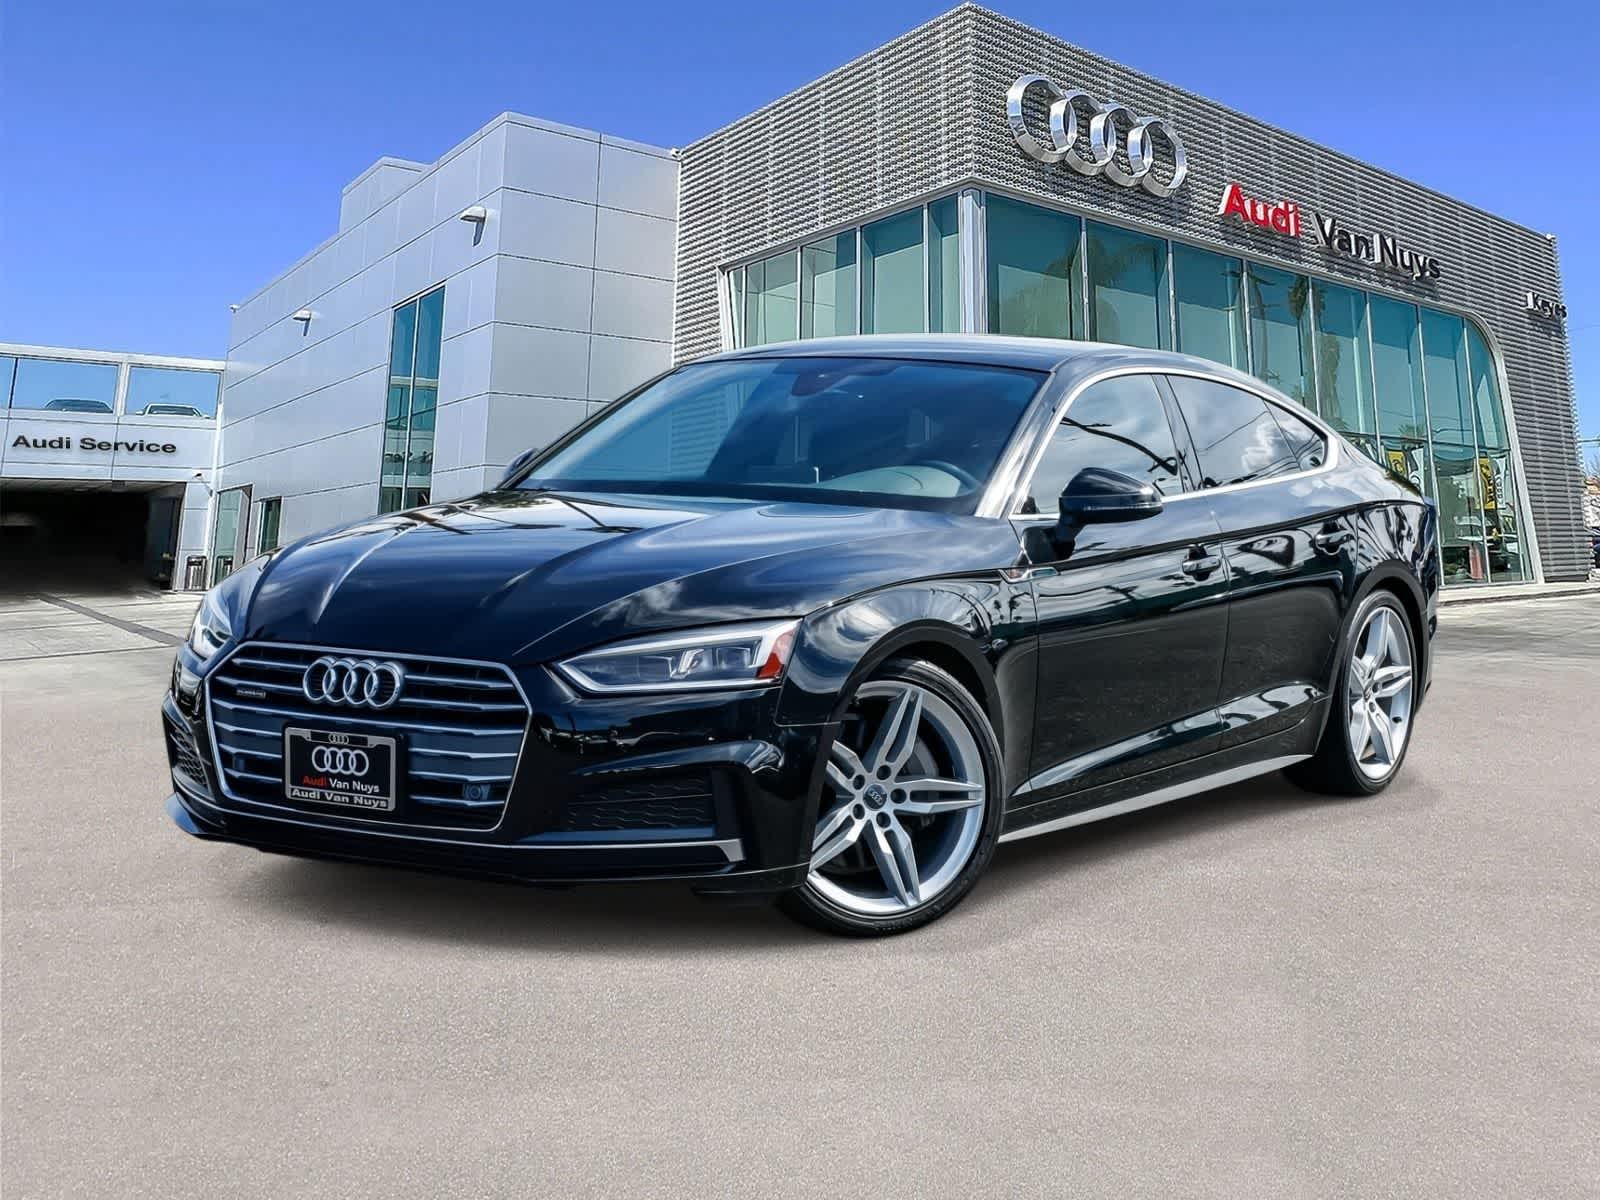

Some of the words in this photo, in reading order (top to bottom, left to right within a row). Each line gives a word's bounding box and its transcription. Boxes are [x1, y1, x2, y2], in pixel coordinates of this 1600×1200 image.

[1217, 183, 1301, 237] Audi
[1312, 212, 1369, 258] Van
[1373, 232, 1441, 280] Nuys
[12, 435, 71, 449] Audi
[79, 437, 177, 453] Service
[303, 776, 328, 787] Audi
[329, 778, 350, 790] Van
[352, 781, 380, 794] Nuys
[292, 789, 320, 799] Audi
[325, 793, 349, 803] Van
[354, 796, 387, 808] Nuys
